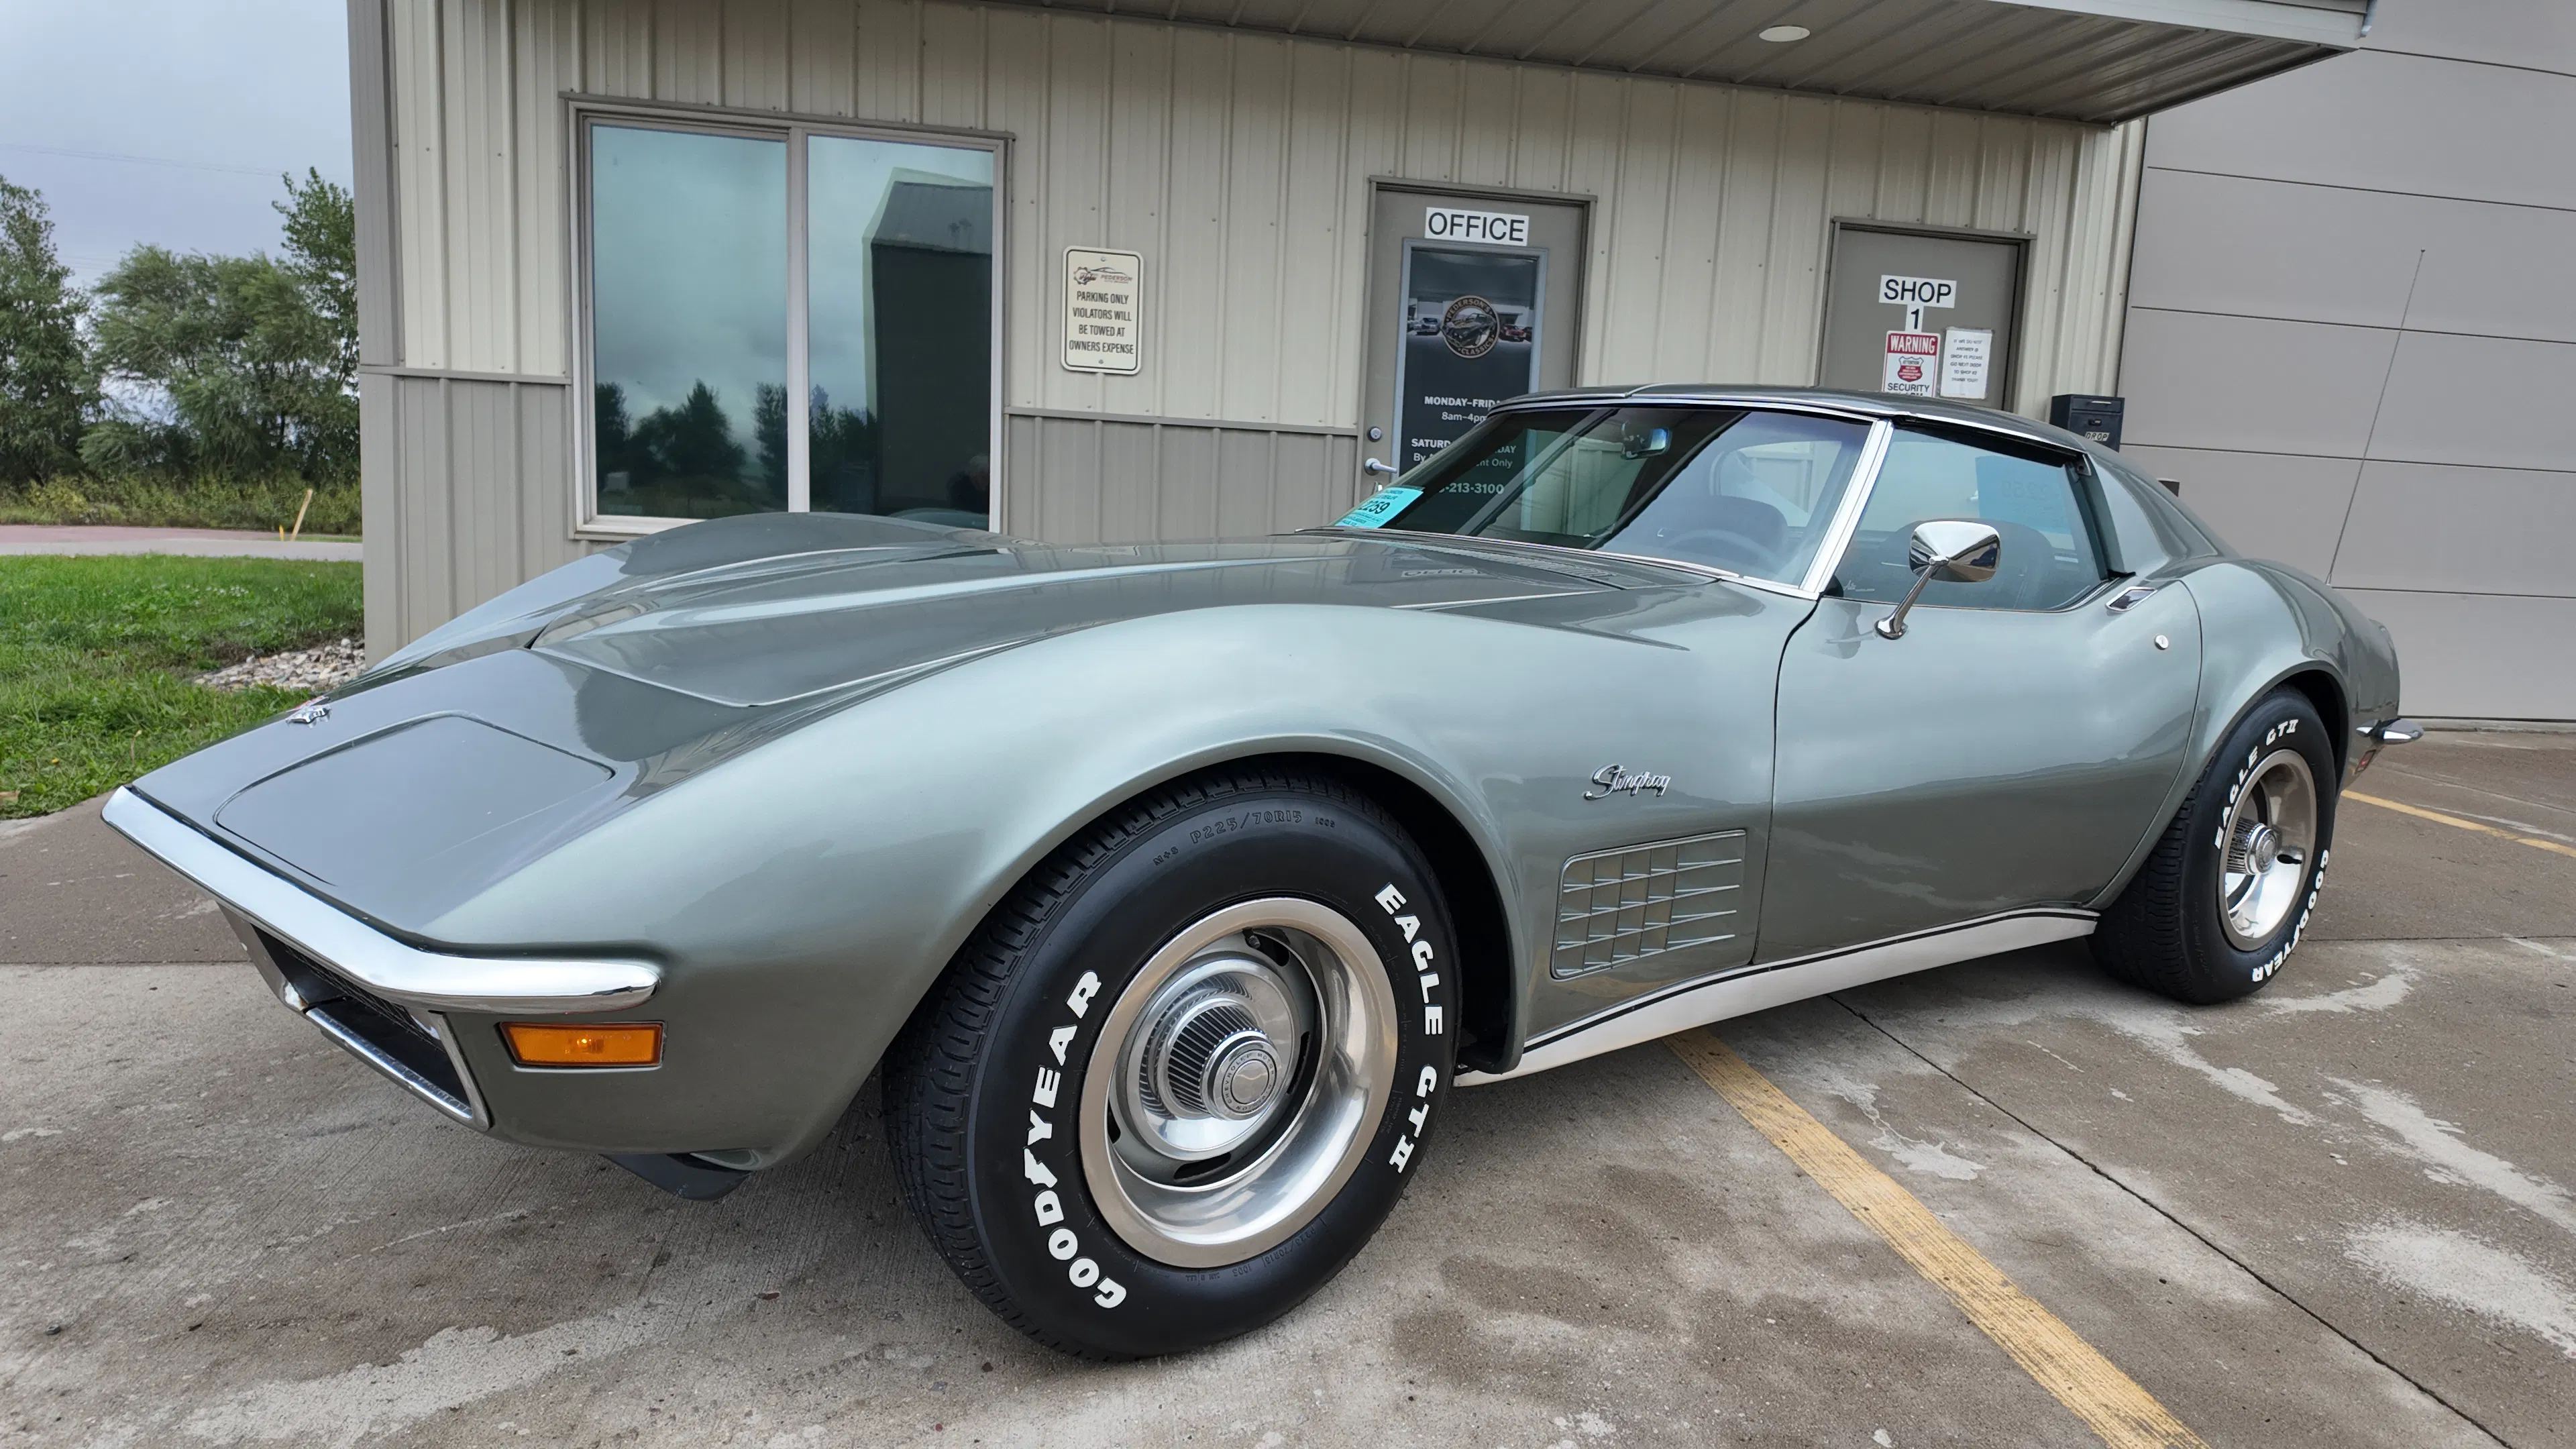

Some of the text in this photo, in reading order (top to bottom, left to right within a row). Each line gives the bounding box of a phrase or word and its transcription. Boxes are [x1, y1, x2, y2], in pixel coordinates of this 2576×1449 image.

[1429, 212, 1525, 242] OFFICE
[1077, 290, 1129, 305] PARKING ONLY
[1884, 279, 1951, 303] SHOP
[1073, 307, 1132, 321] VIOLATORS WILL
[1911, 308, 1920, 329] 1
[1079, 324, 1125, 337] BE TOWED AT
[1069, 340, 1134, 354] OWNERS EXPENSE
[1460, 337, 1494, 355] CLASSICS
[1890, 335, 1936, 354] WARNING
[1887, 382, 1930, 392] SECURITY
[1411, 438, 1452, 449] SATURD
[2086, 432, 2107, 441] DROP
[1413, 452, 1426, 464] By
[1492, 458, 1513, 469] Only
[1582, 763, 1671, 800] Stingray
[2214, 745, 2258, 849] EAGLE
[1189, 810, 1303, 845] P225/70R15
[1374, 882, 1443, 1036] EAGLE
[1023, 969, 1128, 1309] GOODYEAR
